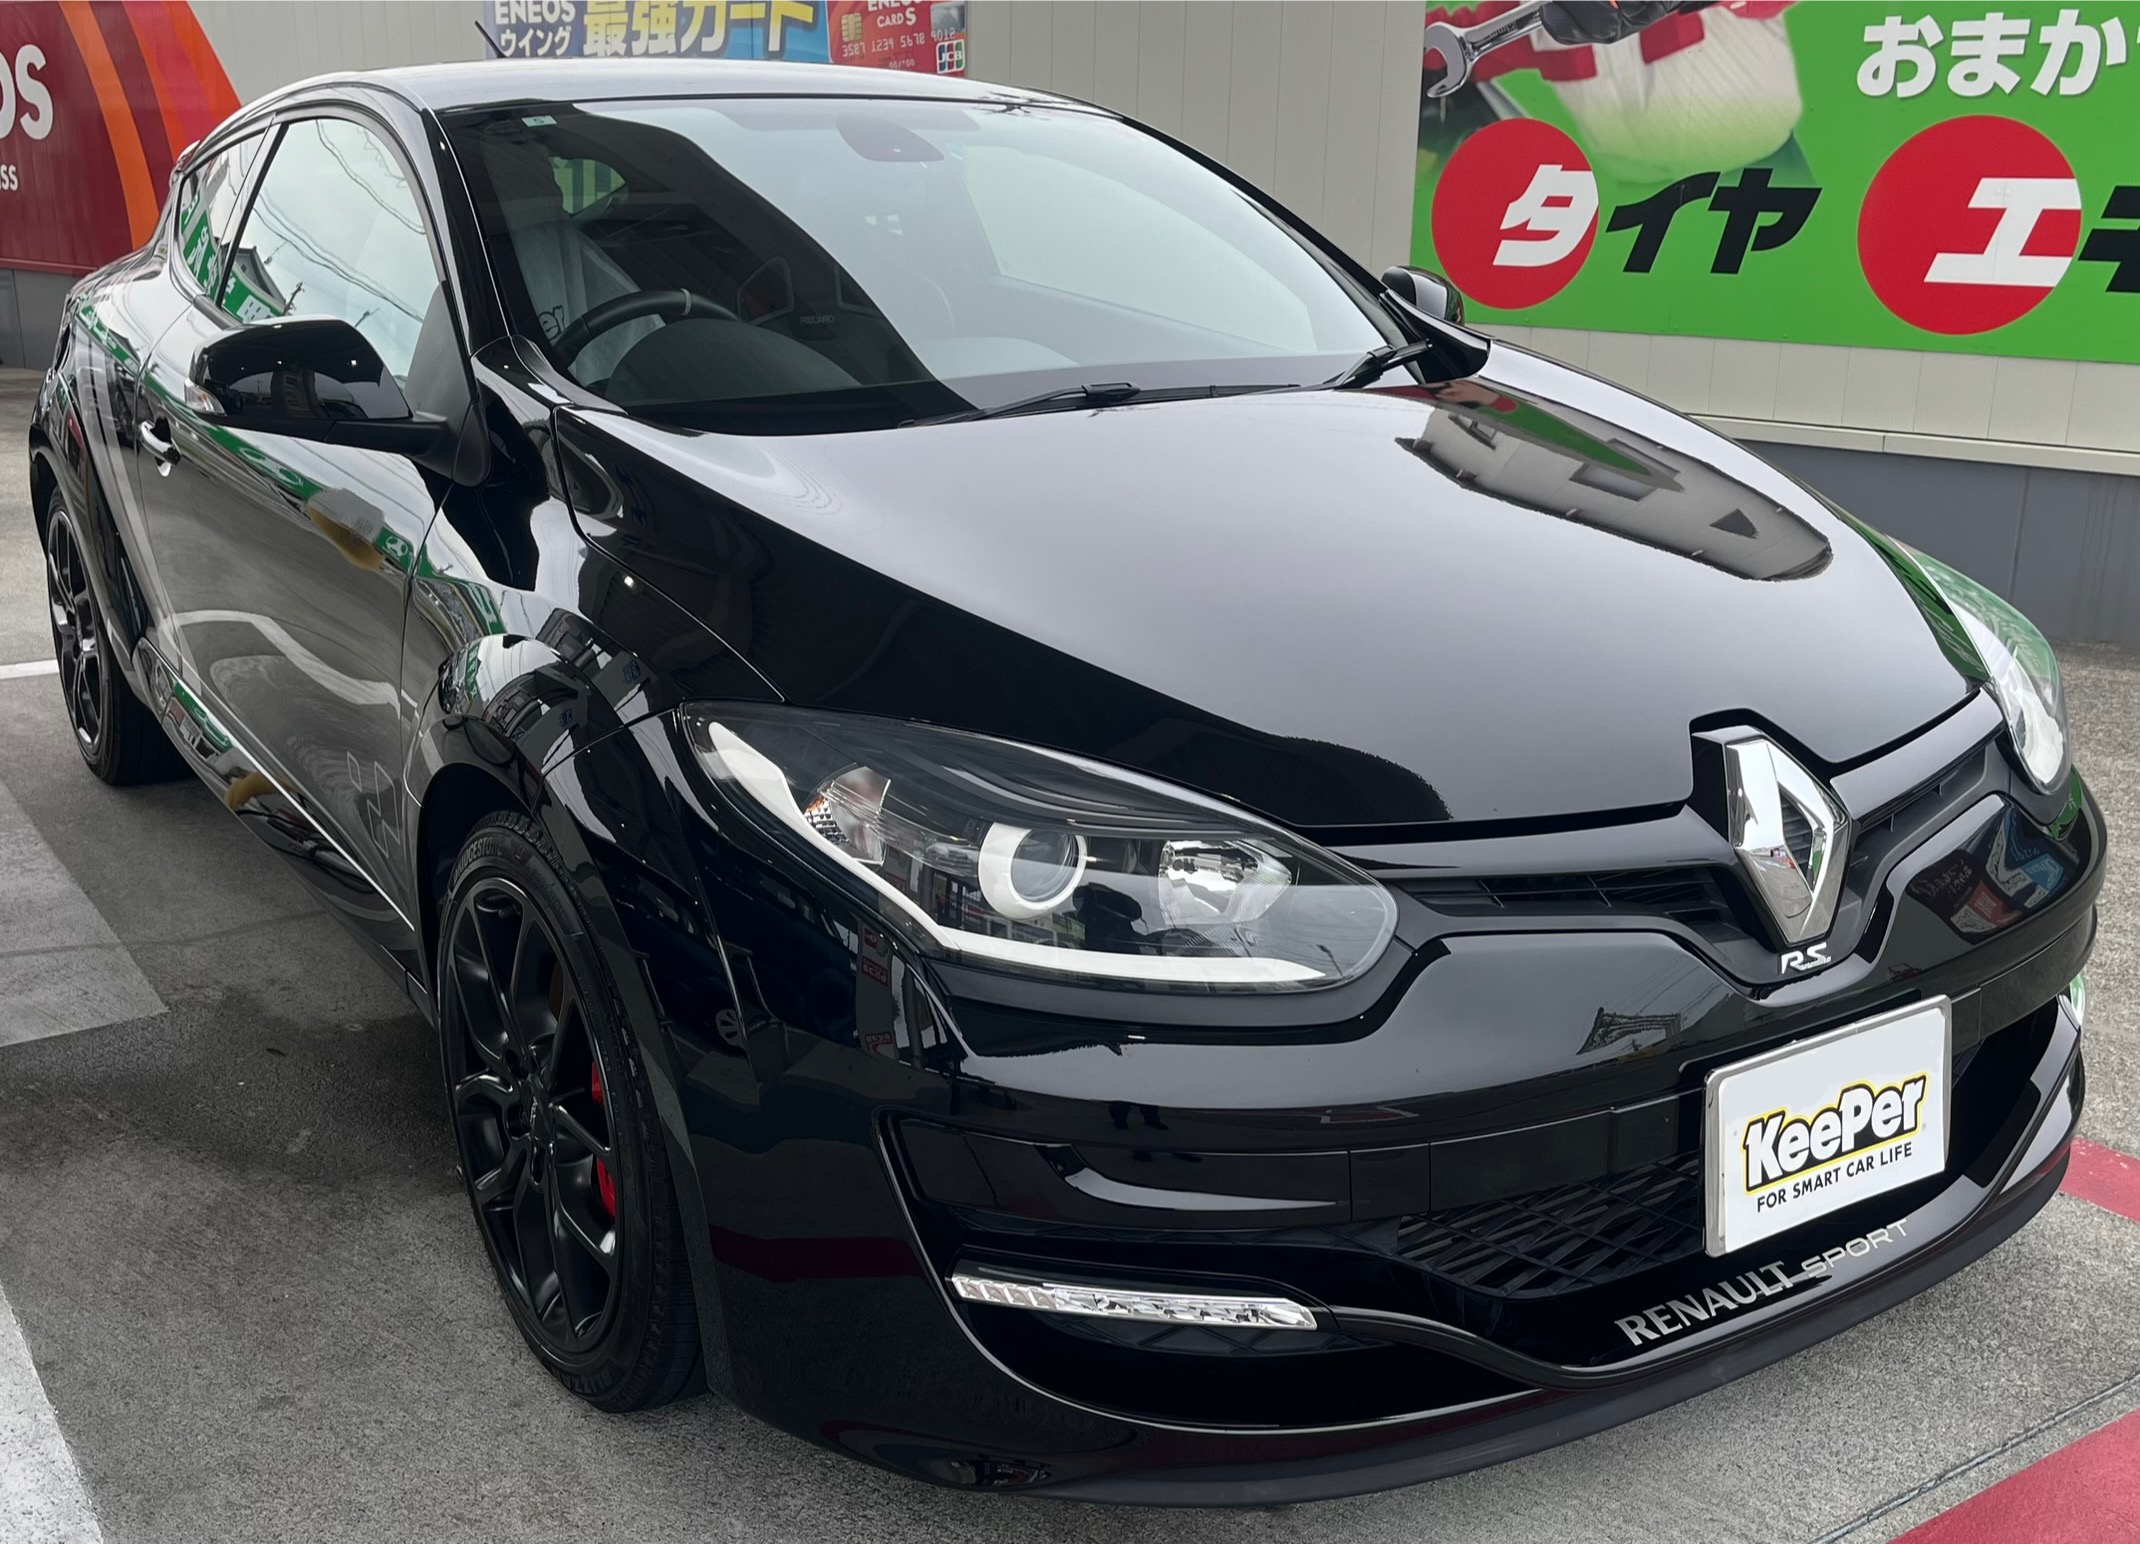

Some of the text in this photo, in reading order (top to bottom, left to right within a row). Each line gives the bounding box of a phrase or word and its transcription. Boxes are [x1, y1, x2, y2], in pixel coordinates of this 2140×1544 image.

[495, 0, 576, 25] ENEOS
[876, 7, 917, 28] CARD S
[500, 26, 572, 57] ウイング
[871, 37, 894, 53] 1234
[1856, 8, 2140, 98] おまか
[1492, 163, 1823, 274] タイヤ
[800, 315, 836, 325] RECARO
[1744, 1075, 1926, 1191] KeePer
[1757, 1141, 1912, 1212] FOR SMART CAR LIFE
[1615, 1218, 1908, 1346] RENAULT SPORT
